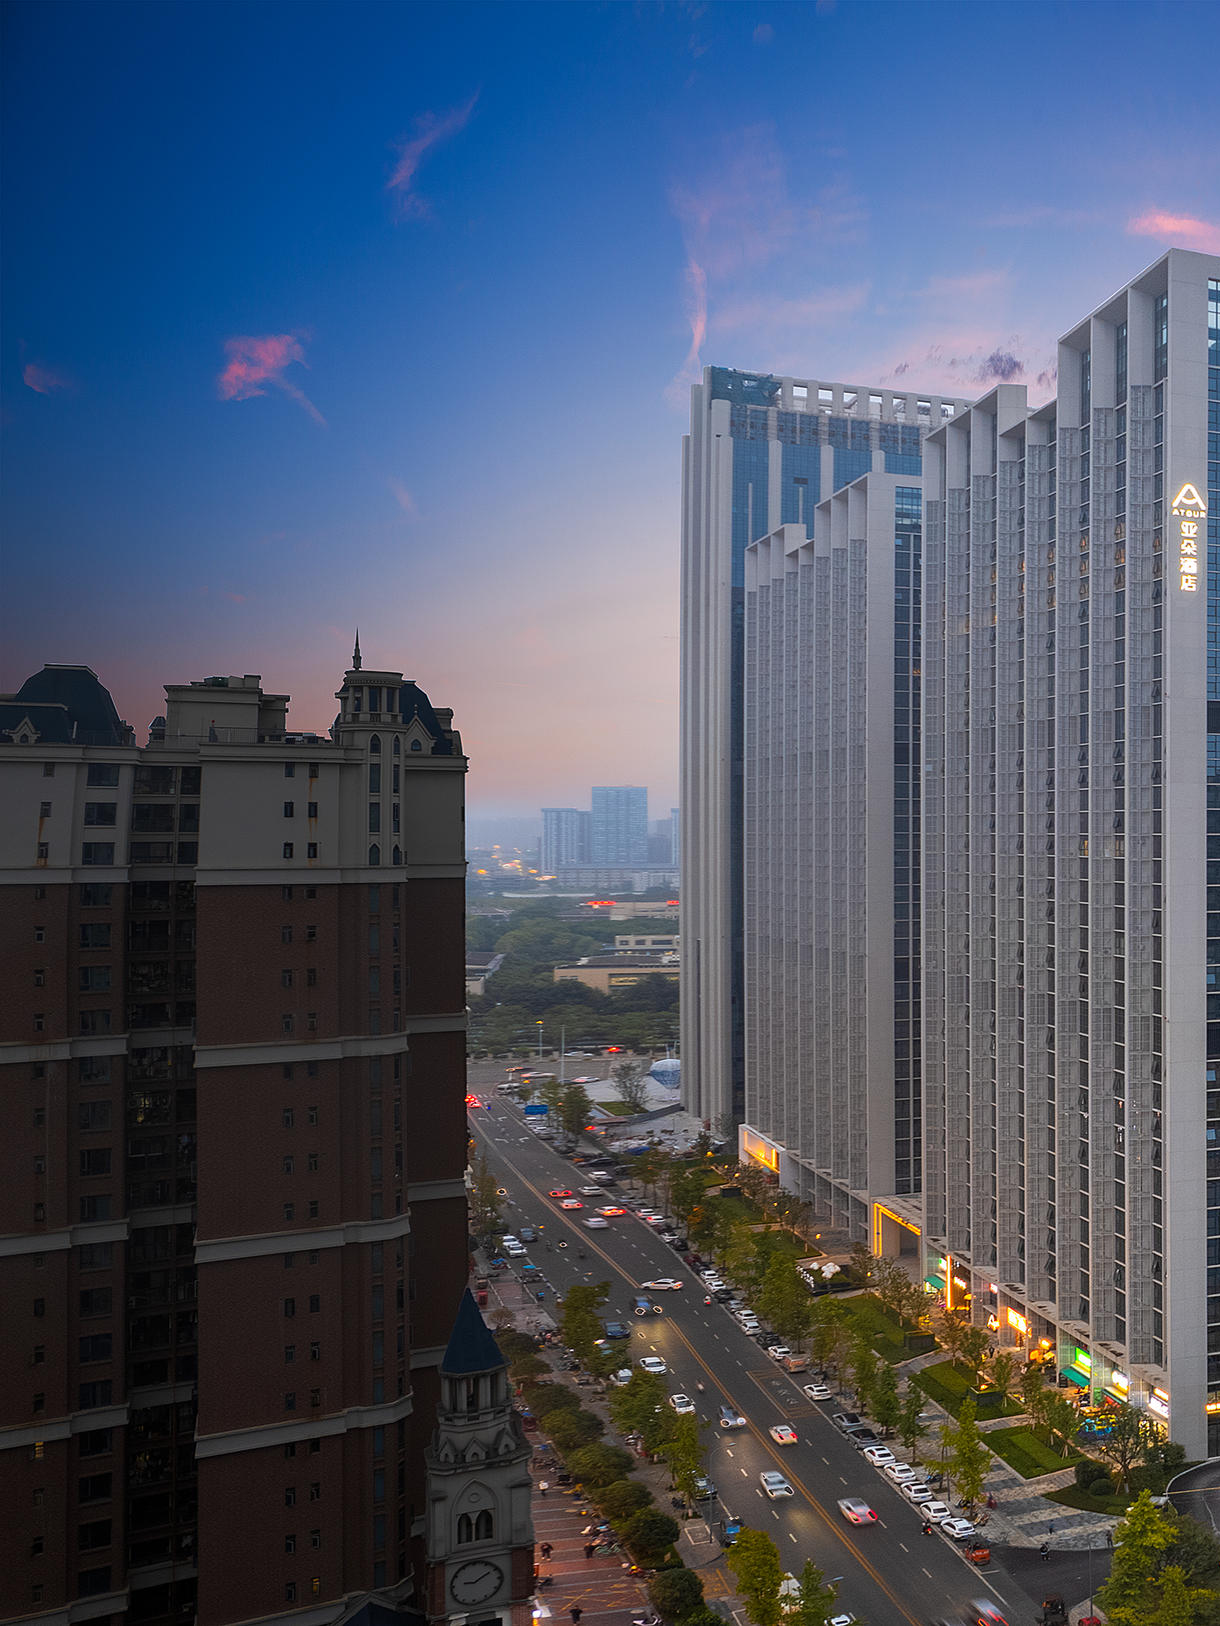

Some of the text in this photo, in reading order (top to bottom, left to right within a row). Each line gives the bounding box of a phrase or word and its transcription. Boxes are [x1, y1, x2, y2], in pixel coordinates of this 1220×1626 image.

[1172, 508, 1206, 518] ATOUR
[1180, 521, 1198, 592] 亚朵酒店
